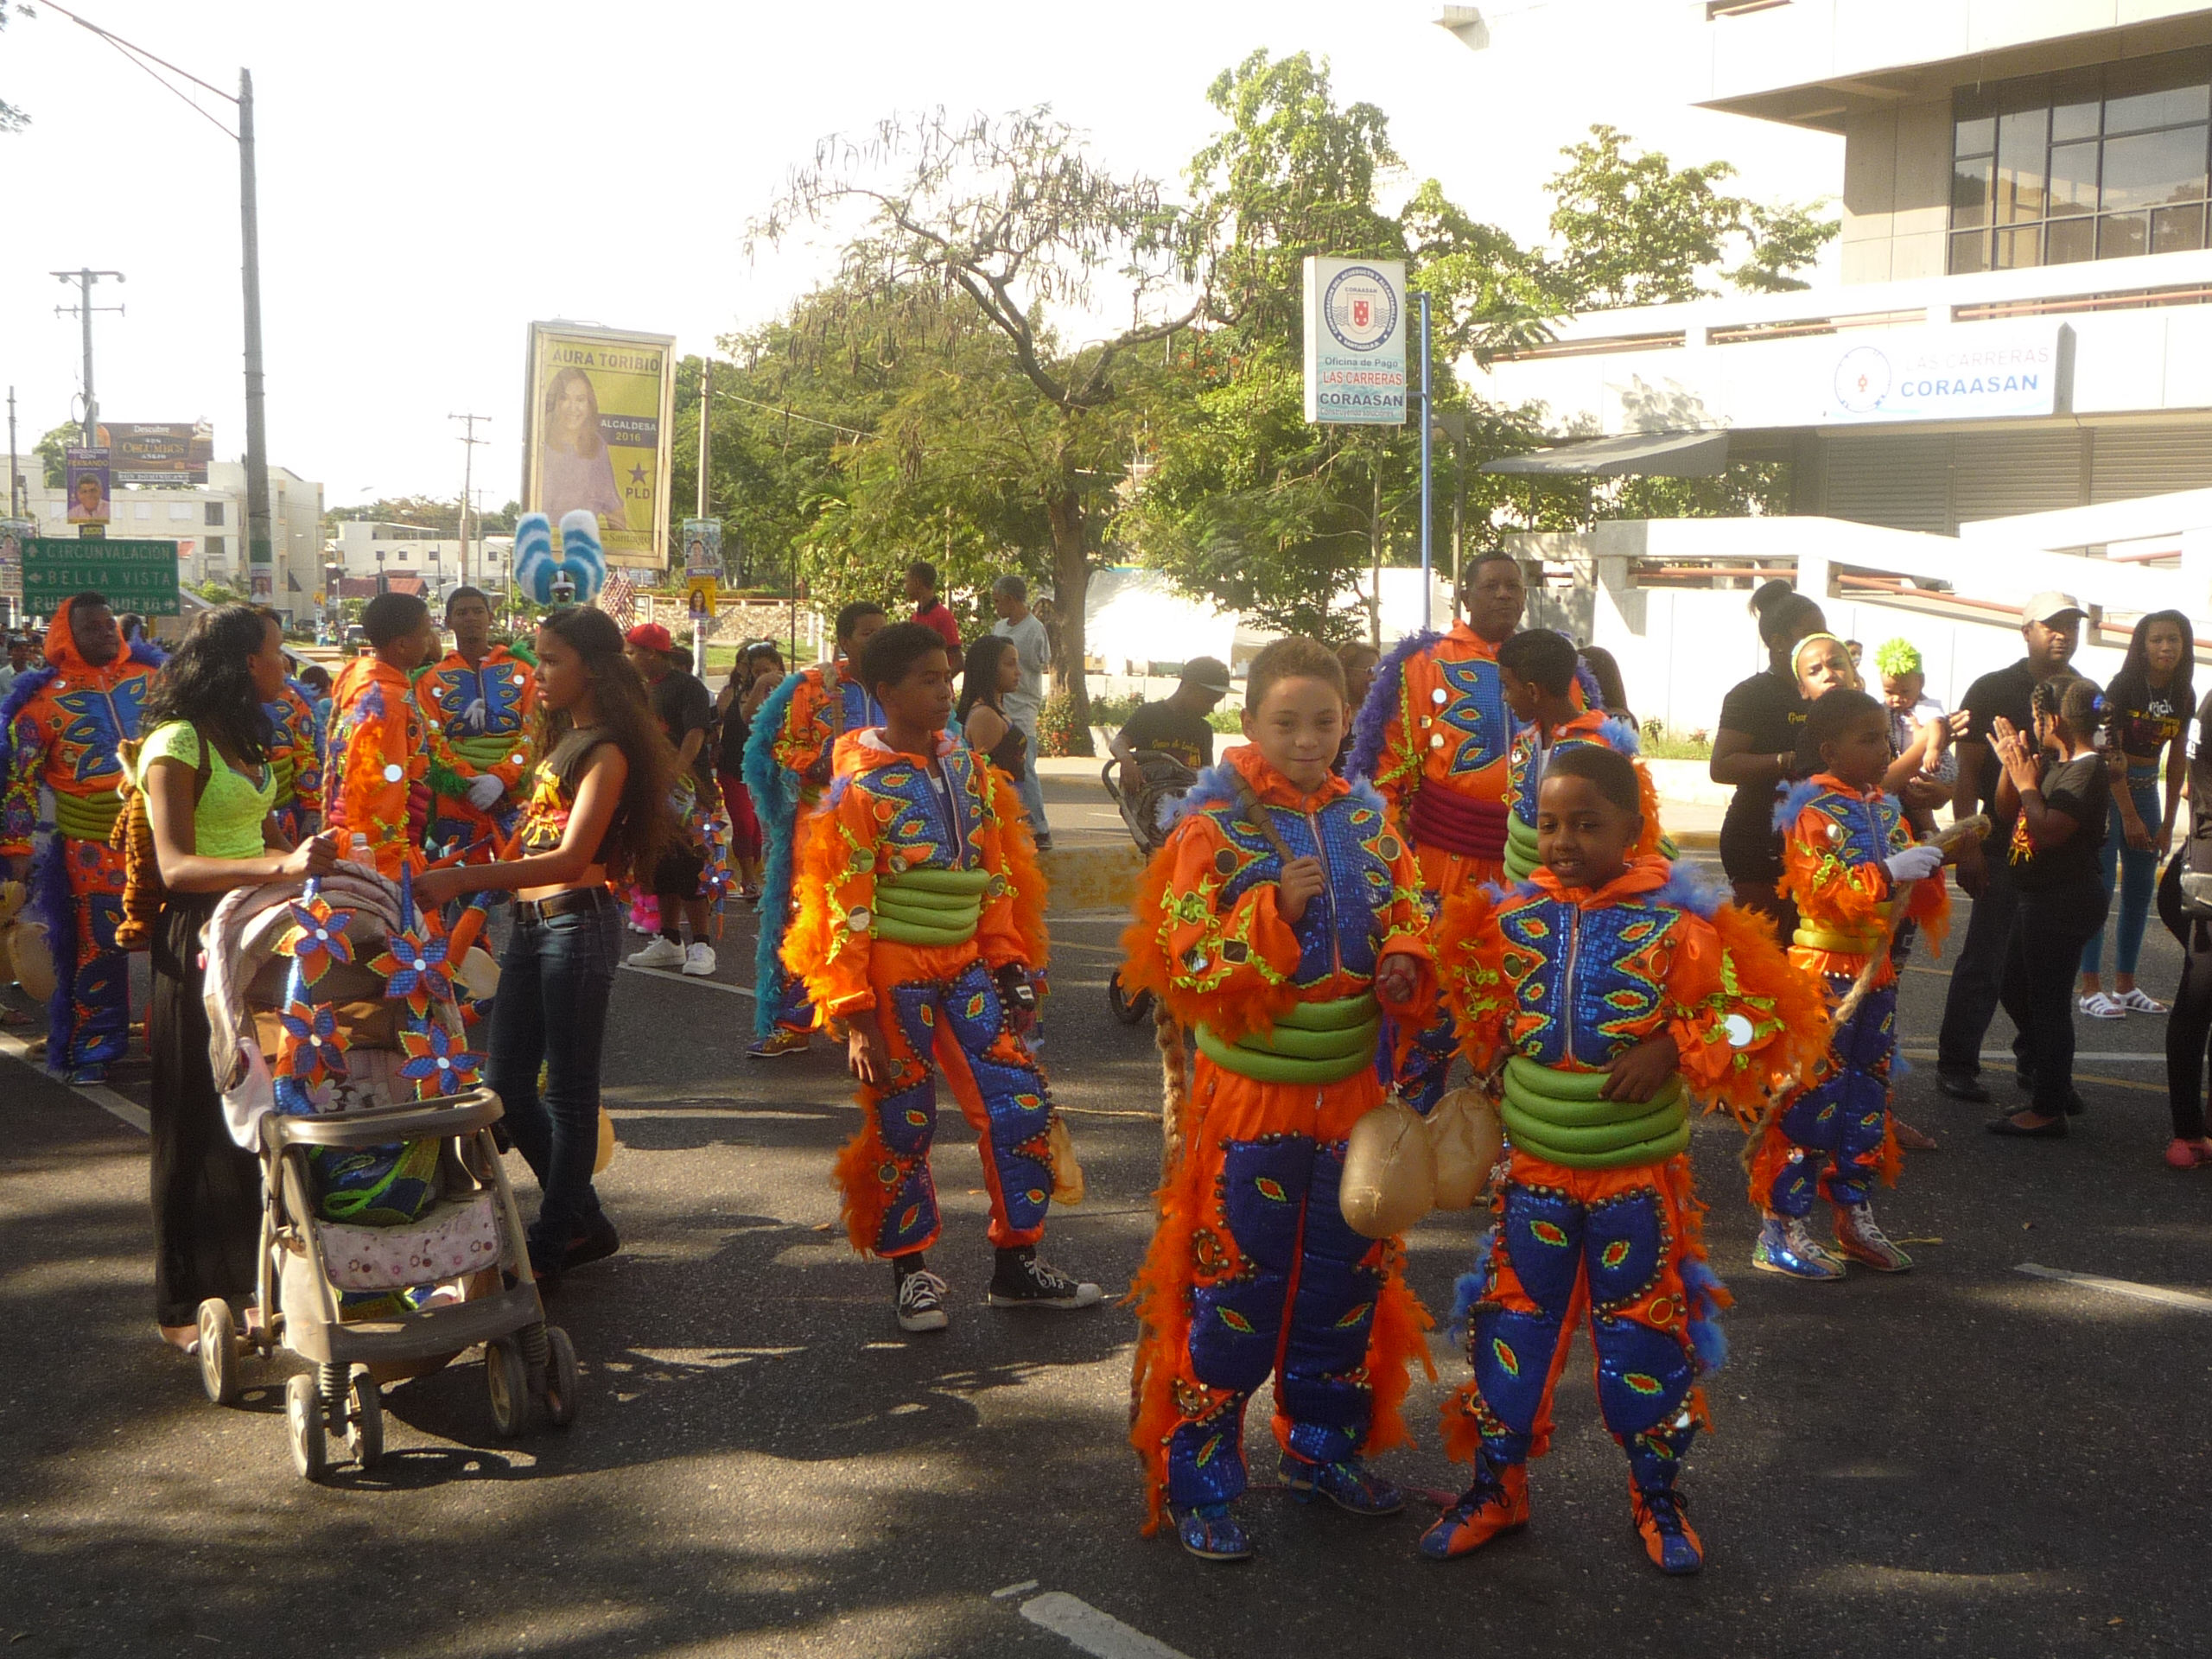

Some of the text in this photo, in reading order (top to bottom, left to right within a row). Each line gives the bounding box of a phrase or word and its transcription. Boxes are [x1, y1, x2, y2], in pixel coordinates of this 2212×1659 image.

[553, 348, 659, 372] AURA TORIBIO
[1325, 357, 1357, 366] Oficina
[1375, 359, 1398, 369] Pago
[1906, 347, 2049, 371] LAS CARRERAS
[1323, 371, 1402, 385] LAS CARRERAS
[1901, 374, 2038, 397] CORAASAN
[1319, 393, 1403, 407] CORAASAN
[133, 424, 170, 434] Descubre
[601, 419, 657, 431] ALCALDESA
[615, 432, 641, 442] 2016
[626, 487, 650, 499] PLD
[48, 570, 171, 586] BELLA VISTA
